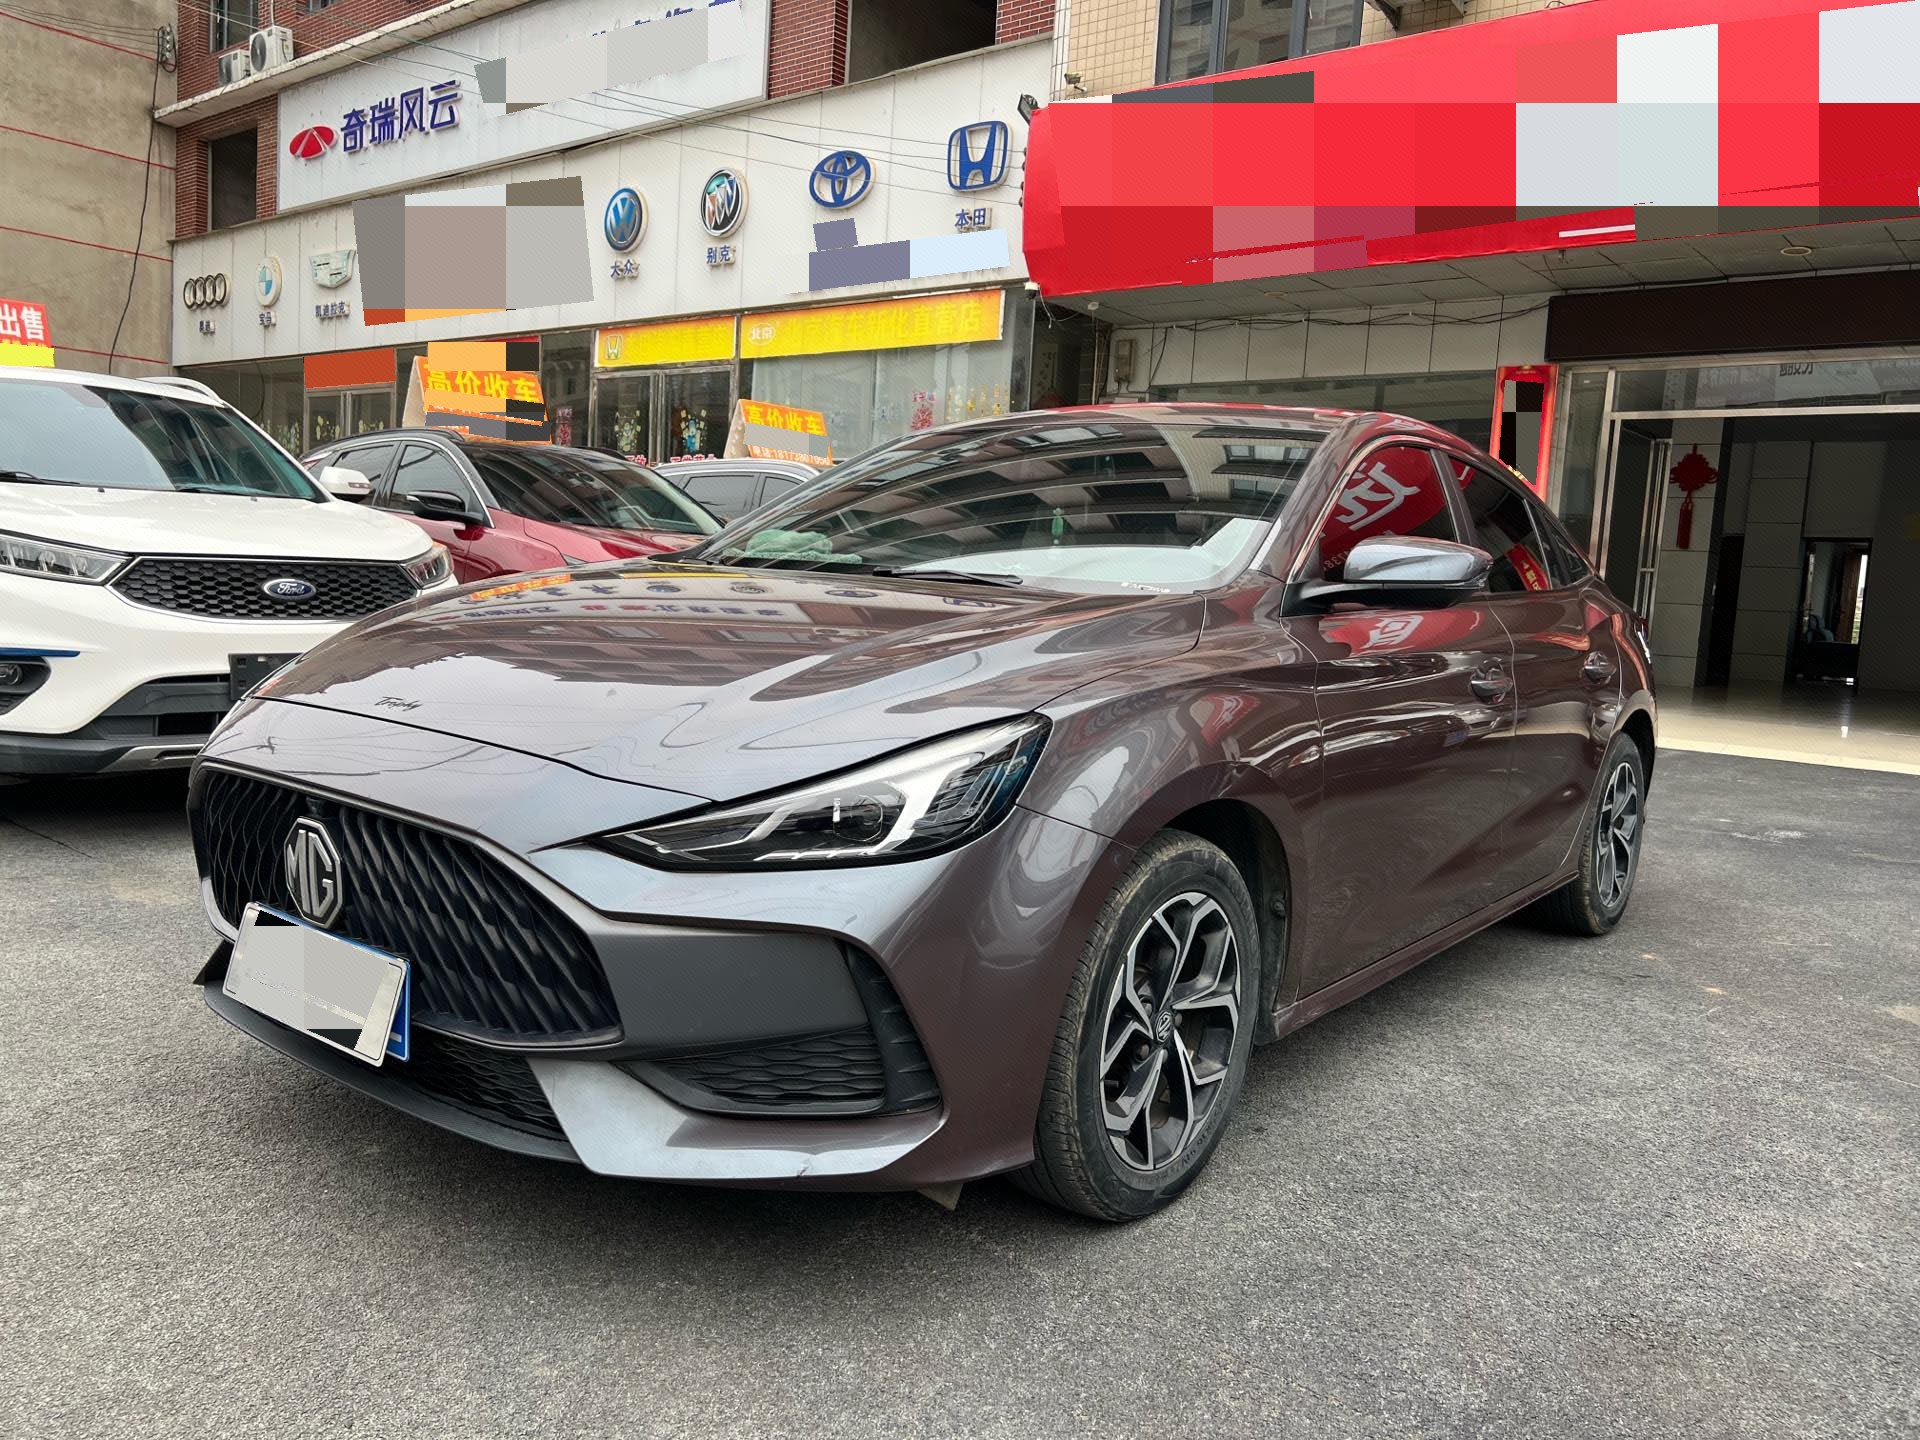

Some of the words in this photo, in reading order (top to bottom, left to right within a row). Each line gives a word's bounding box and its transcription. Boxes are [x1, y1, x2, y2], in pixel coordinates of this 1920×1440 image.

[340, 79, 459, 153] 奇瑞风云
[954, 207, 988, 229] 本田
[705, 245, 732, 265] 别克
[610, 258, 635, 278] 大众
[0, 303, 45, 341] 出售
[750, 327, 774, 341] 北京
[427, 370, 541, 403] 高价收车
[746, 405, 824, 437] 高价收车
[277, 582, 305, 595] Ford
[375, 696, 423, 712] Trophy
[286, 829, 334, 918] MG
